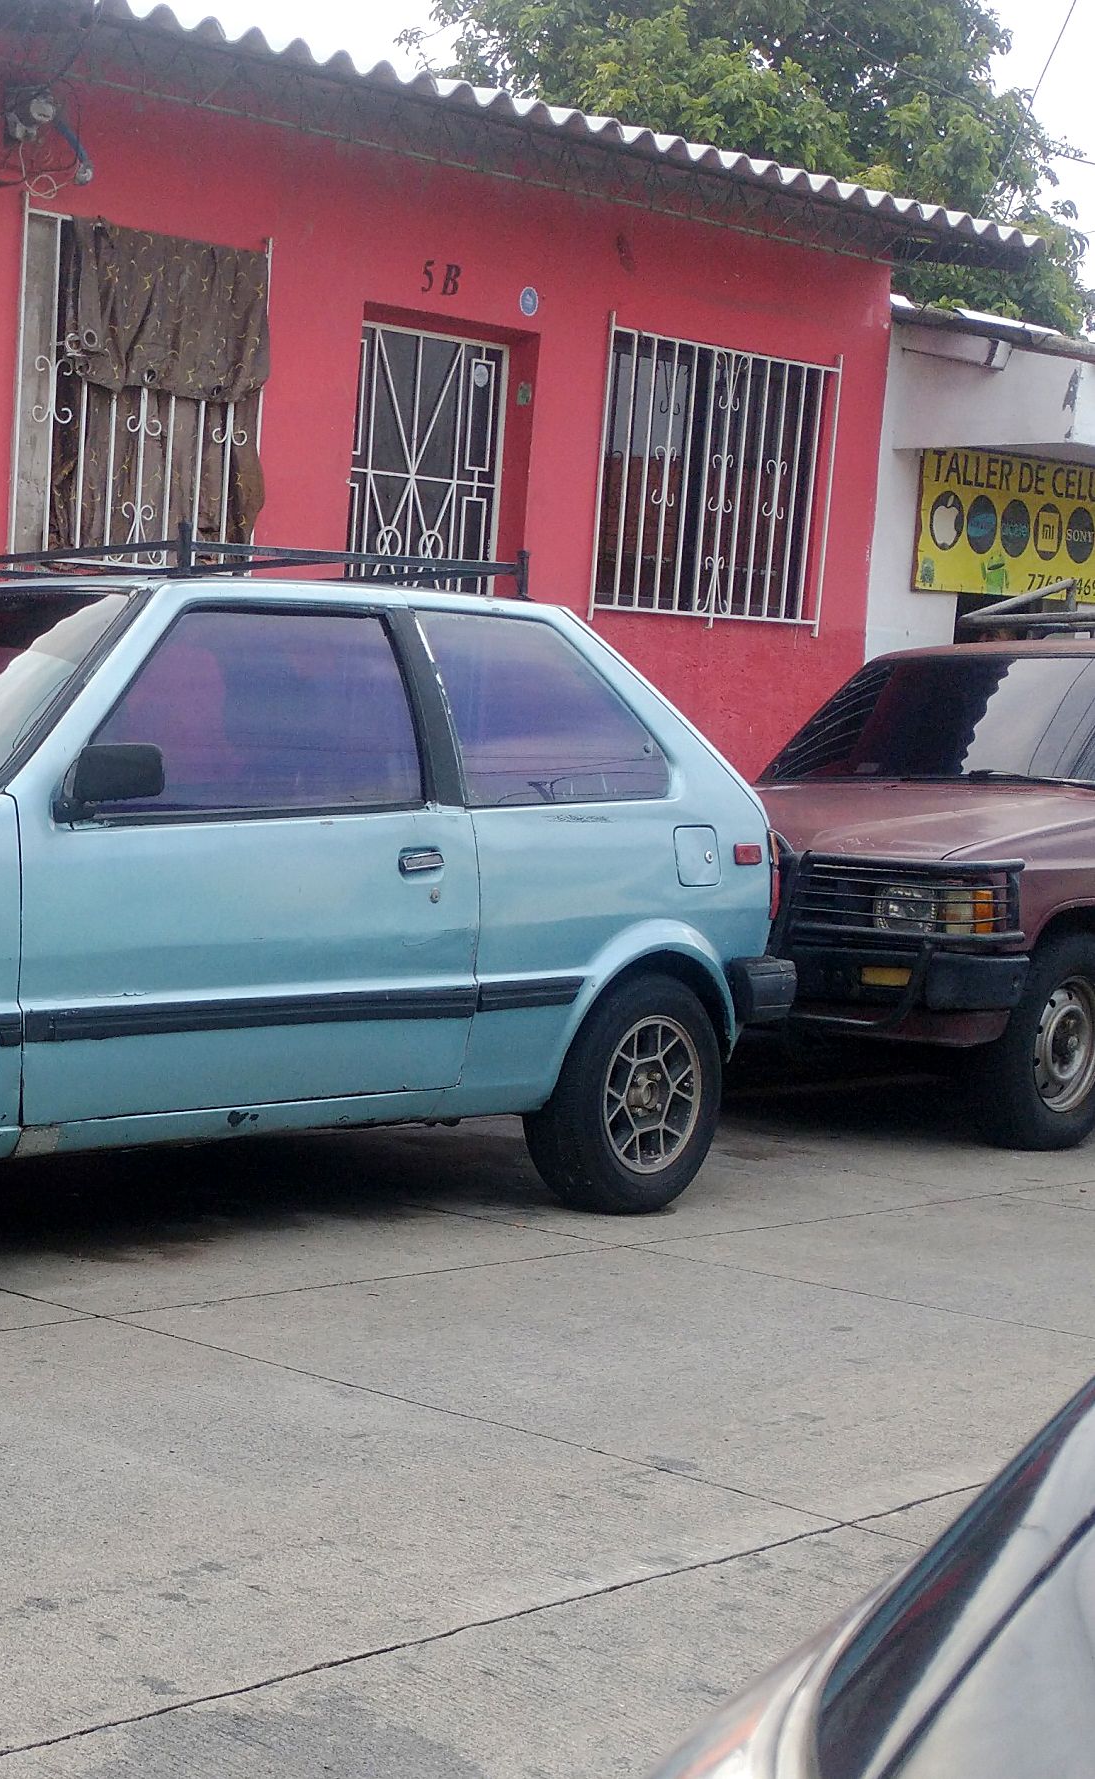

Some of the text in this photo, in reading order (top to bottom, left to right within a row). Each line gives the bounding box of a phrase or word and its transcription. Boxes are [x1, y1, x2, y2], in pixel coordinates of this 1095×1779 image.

[421, 259, 462, 295] 5 B
[933, 449, 1013, 491] TALLER
[1017, 461, 1046, 495] DE
[1066, 528, 1095, 543] SONY
